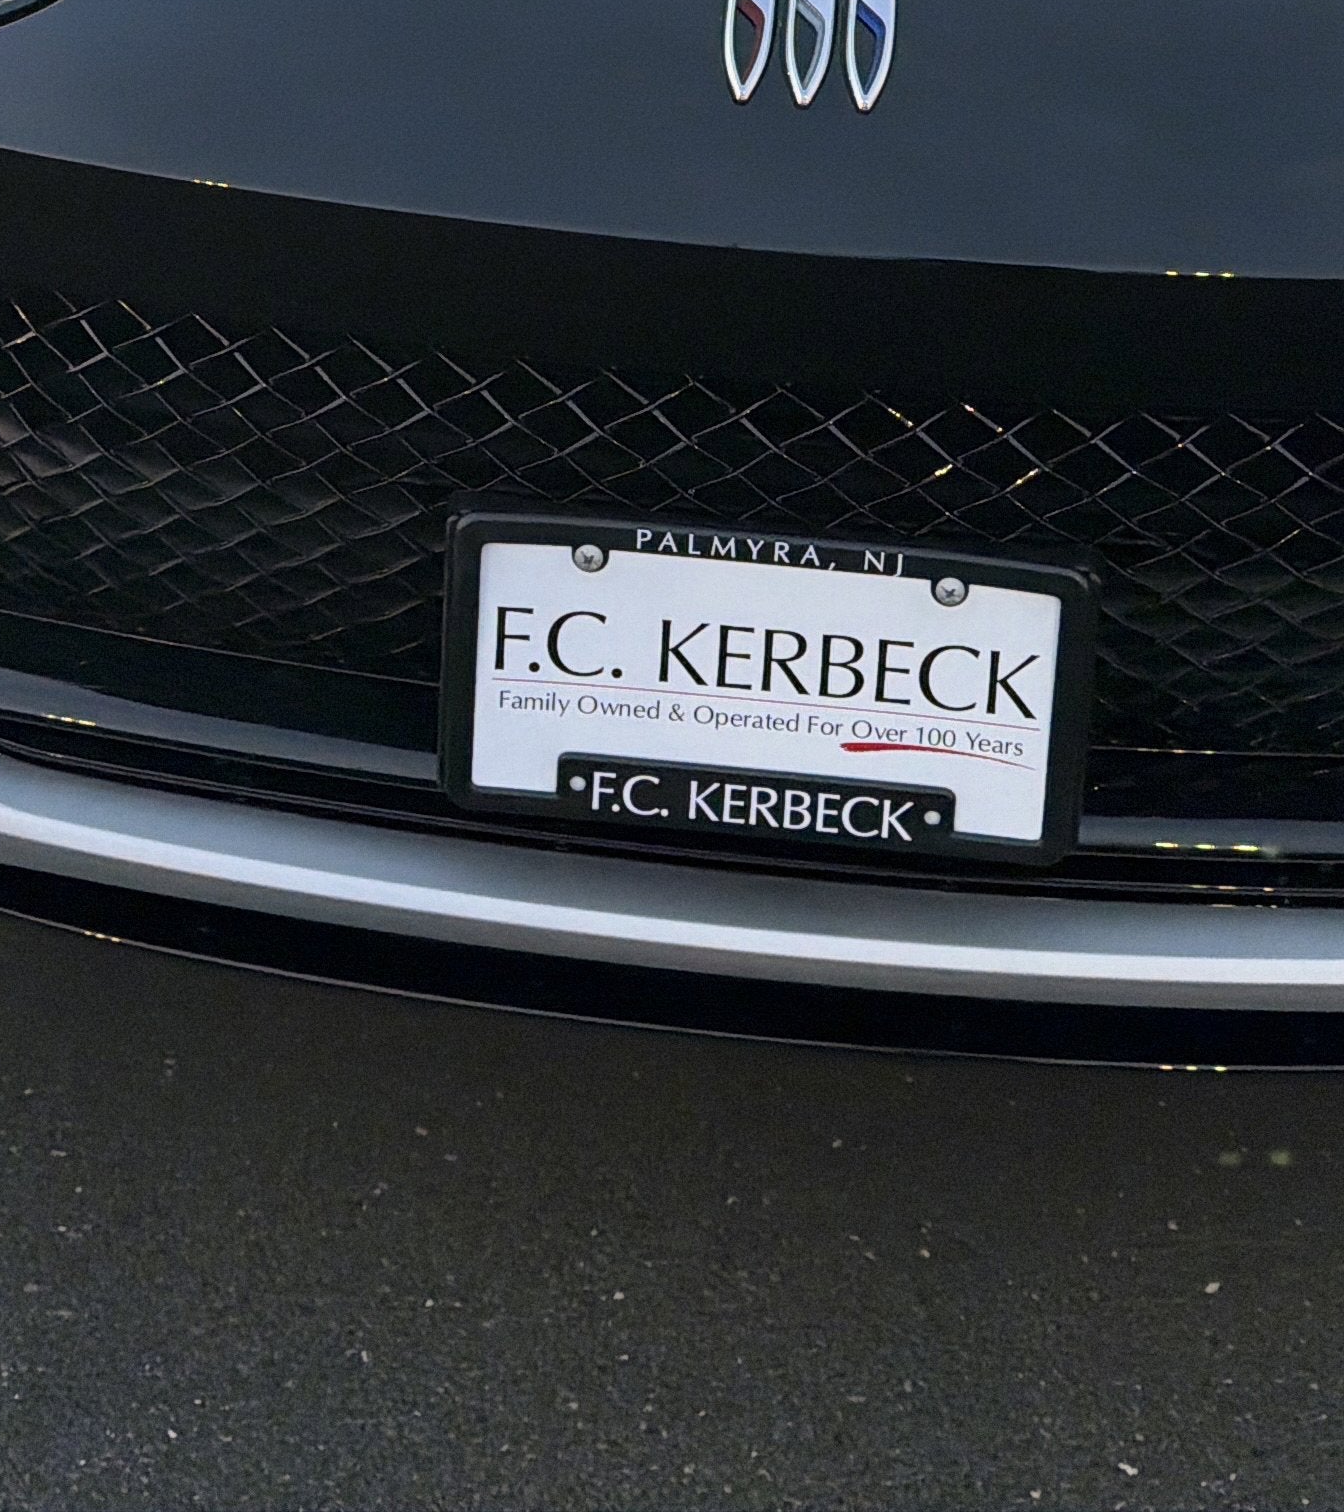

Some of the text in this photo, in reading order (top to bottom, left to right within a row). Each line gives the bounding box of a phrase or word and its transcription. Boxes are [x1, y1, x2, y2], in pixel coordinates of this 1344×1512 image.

[635, 528, 904, 578] PALMYRA, NJ
[493, 605, 1042, 720] F.C. KERBECK
[499, 689, 1024, 757] Family Owned & Operated For Over 100 Years
[590, 771, 915, 842] F.C. KERBECK
